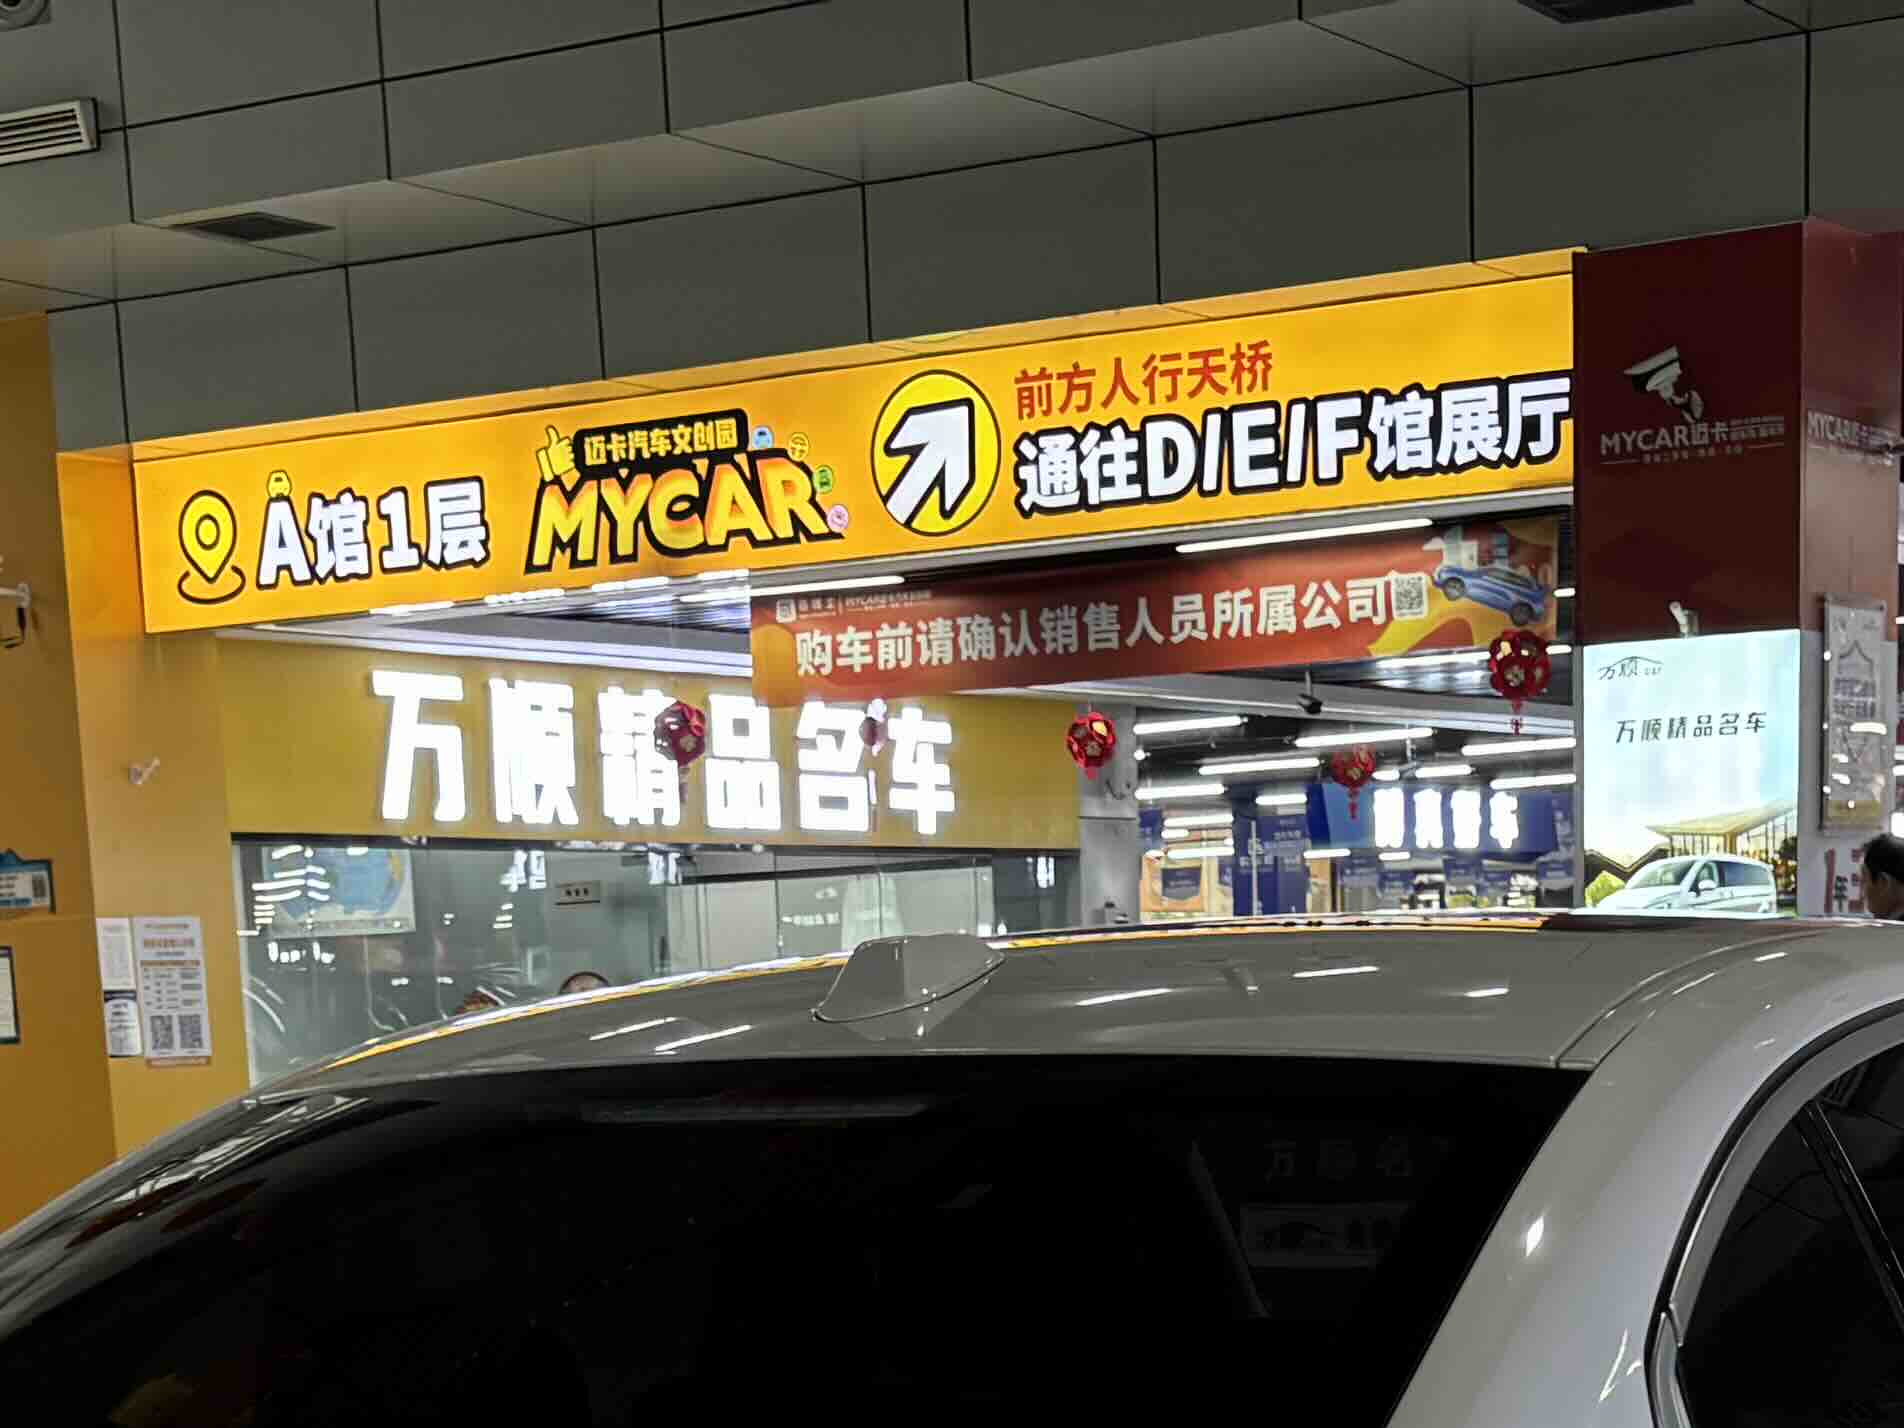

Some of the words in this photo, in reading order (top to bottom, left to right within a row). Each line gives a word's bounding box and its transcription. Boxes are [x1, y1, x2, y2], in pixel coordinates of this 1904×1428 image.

[1014, 339, 1273, 420] 前方人行天桥
[584, 417, 739, 466] 迈卡汽车文创园
[1020, 376, 1572, 511] 通往D/E/F馆展厅
[257, 480, 488, 587] A馆1层
[532, 457, 830, 566] MYCAR
[796, 577, 1389, 677] 购车前请确认销售人员所属公司
[1615, 711, 1767, 744] 万顺精品名车
